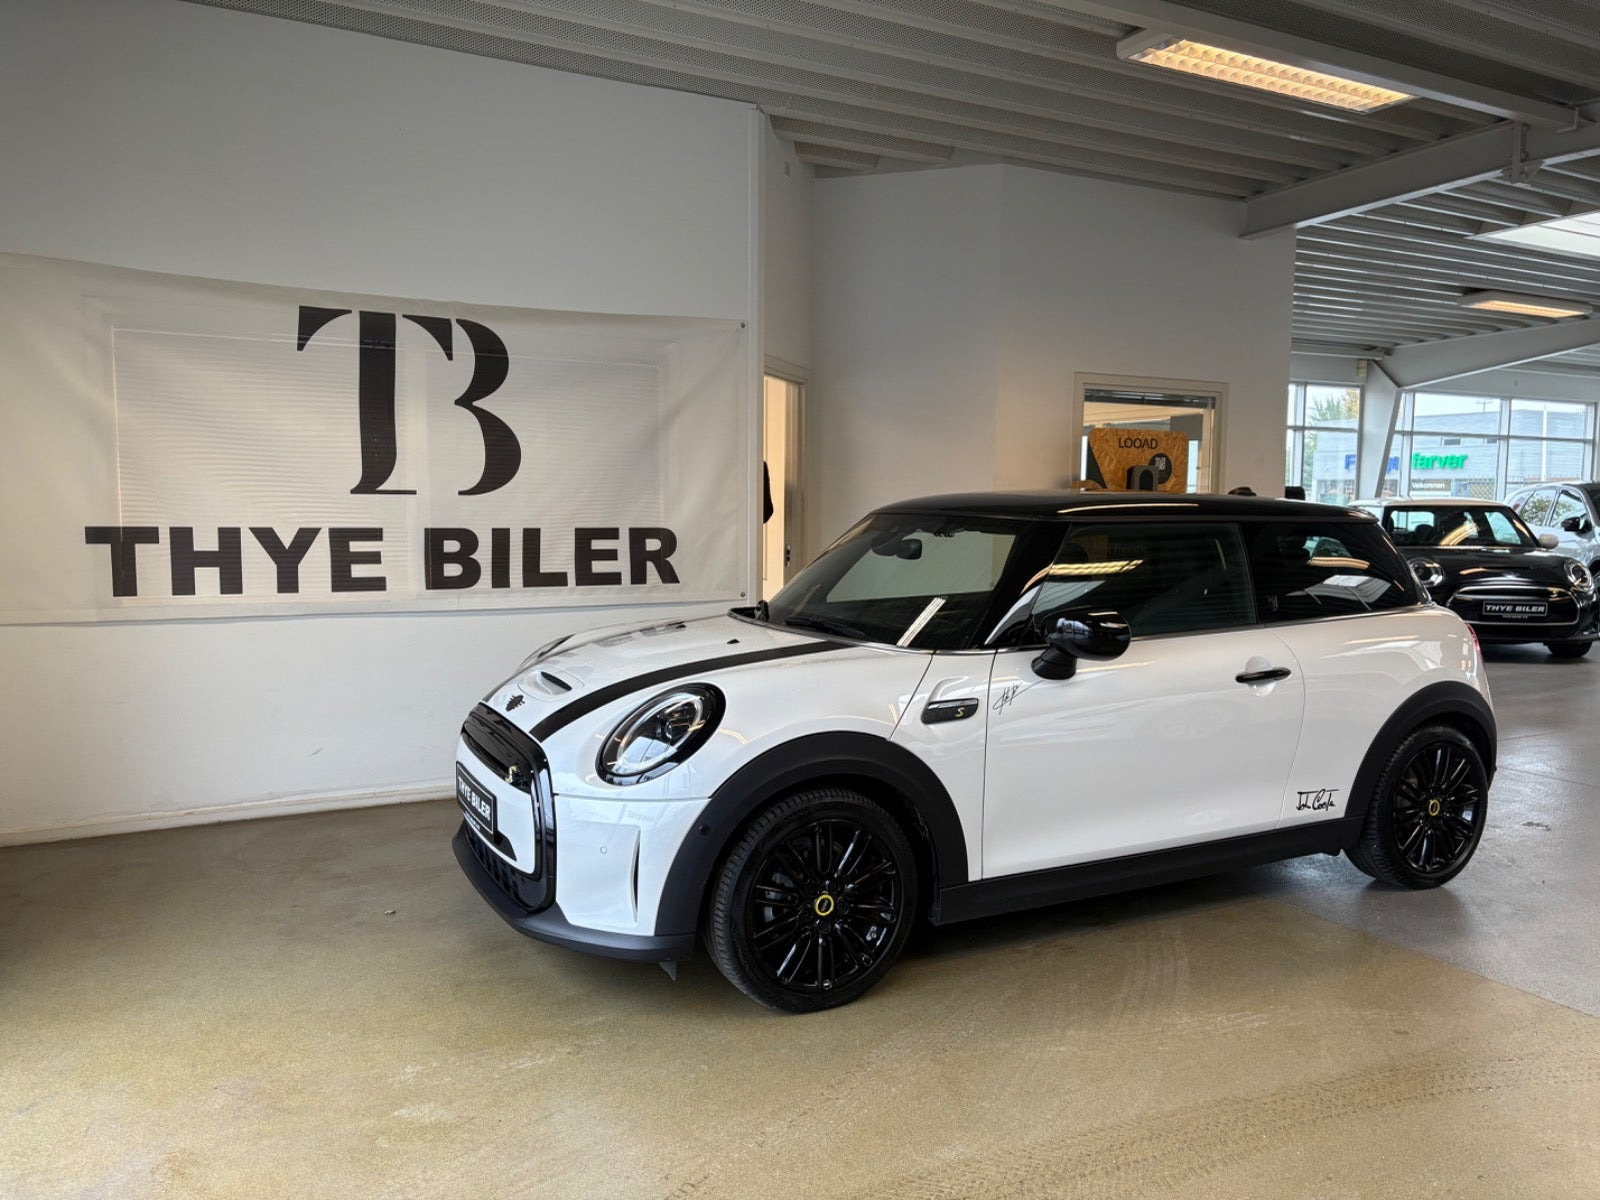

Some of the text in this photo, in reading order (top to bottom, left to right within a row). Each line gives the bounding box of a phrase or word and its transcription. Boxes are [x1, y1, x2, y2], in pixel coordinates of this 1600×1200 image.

[1118, 437, 1158, 450] LOOAD
[85, 526, 680, 597] THYE BILER
[1486, 604, 1545, 613] THYE BILER
[471, 791, 491, 821] BILER
